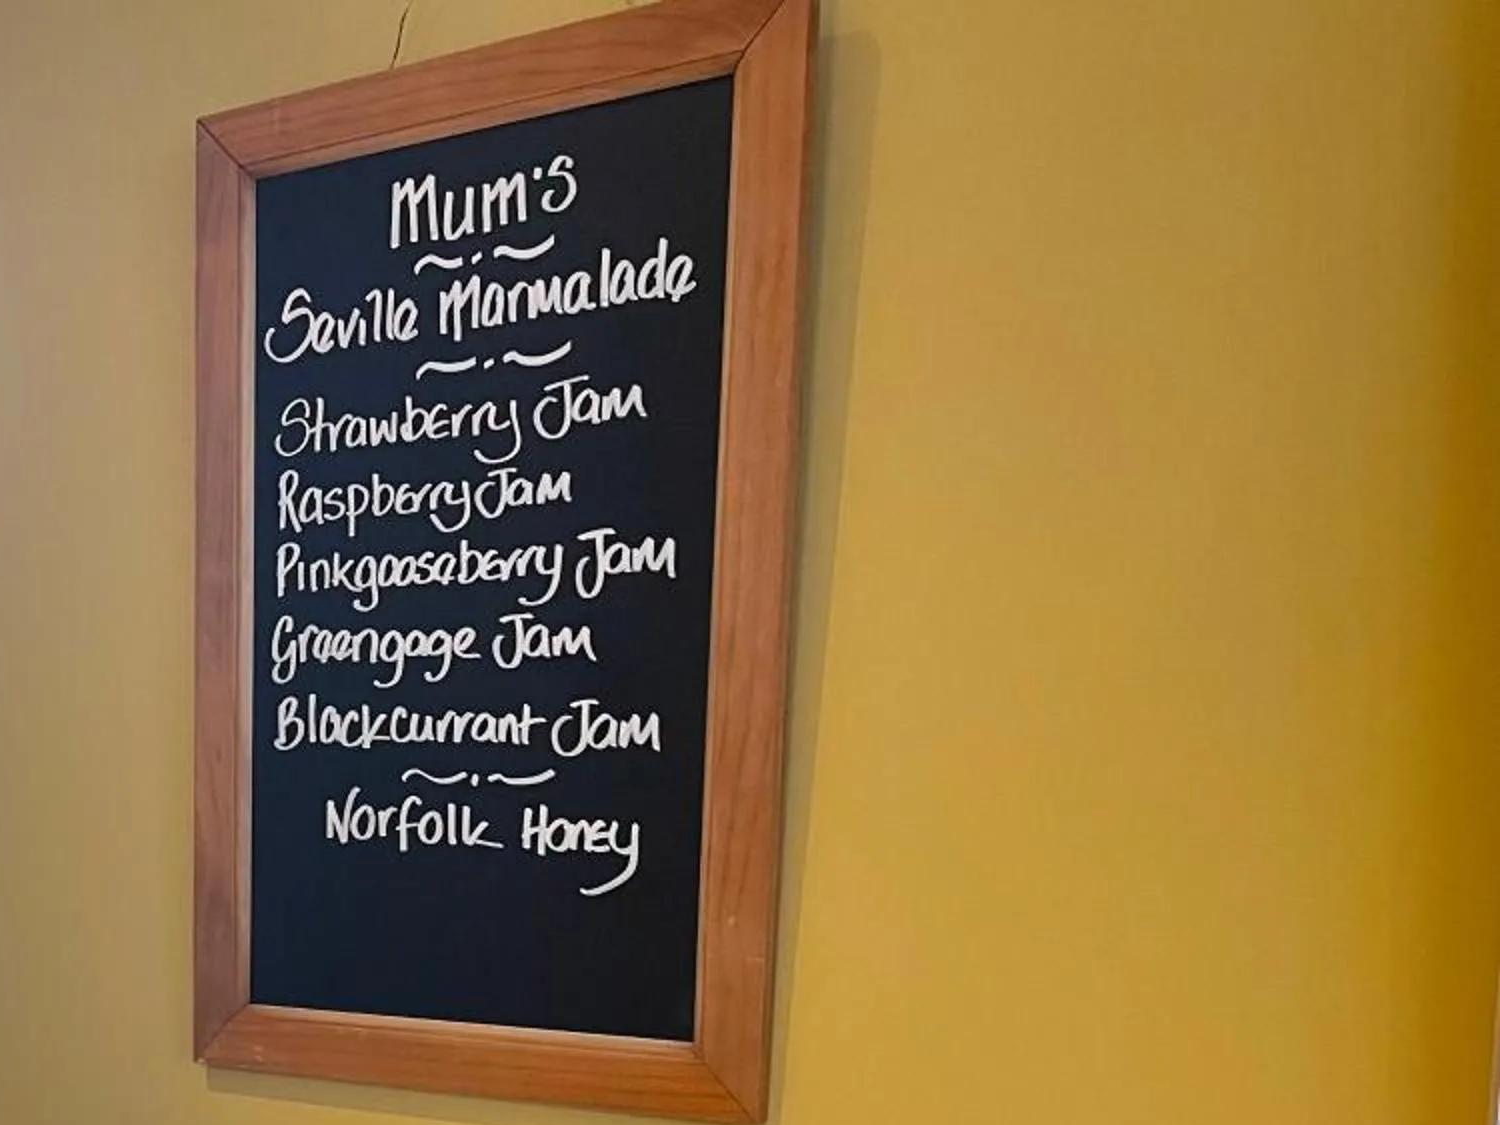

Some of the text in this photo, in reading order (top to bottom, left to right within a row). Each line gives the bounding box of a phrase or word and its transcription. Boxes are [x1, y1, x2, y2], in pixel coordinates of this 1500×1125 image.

[390, 155, 577, 249] Mum's
[264, 238, 697, 363] Seville Marmalade
[274, 374, 647, 464] Strawberry Jam
[277, 467, 573, 537] Raspberry Jam
[575, 527, 676, 599] Jam
[271, 612, 597, 688] Greengage Jam
[273, 694, 661, 757] Blackcurrant Jam
[326, 786, 640, 896] Norfolk Honey
